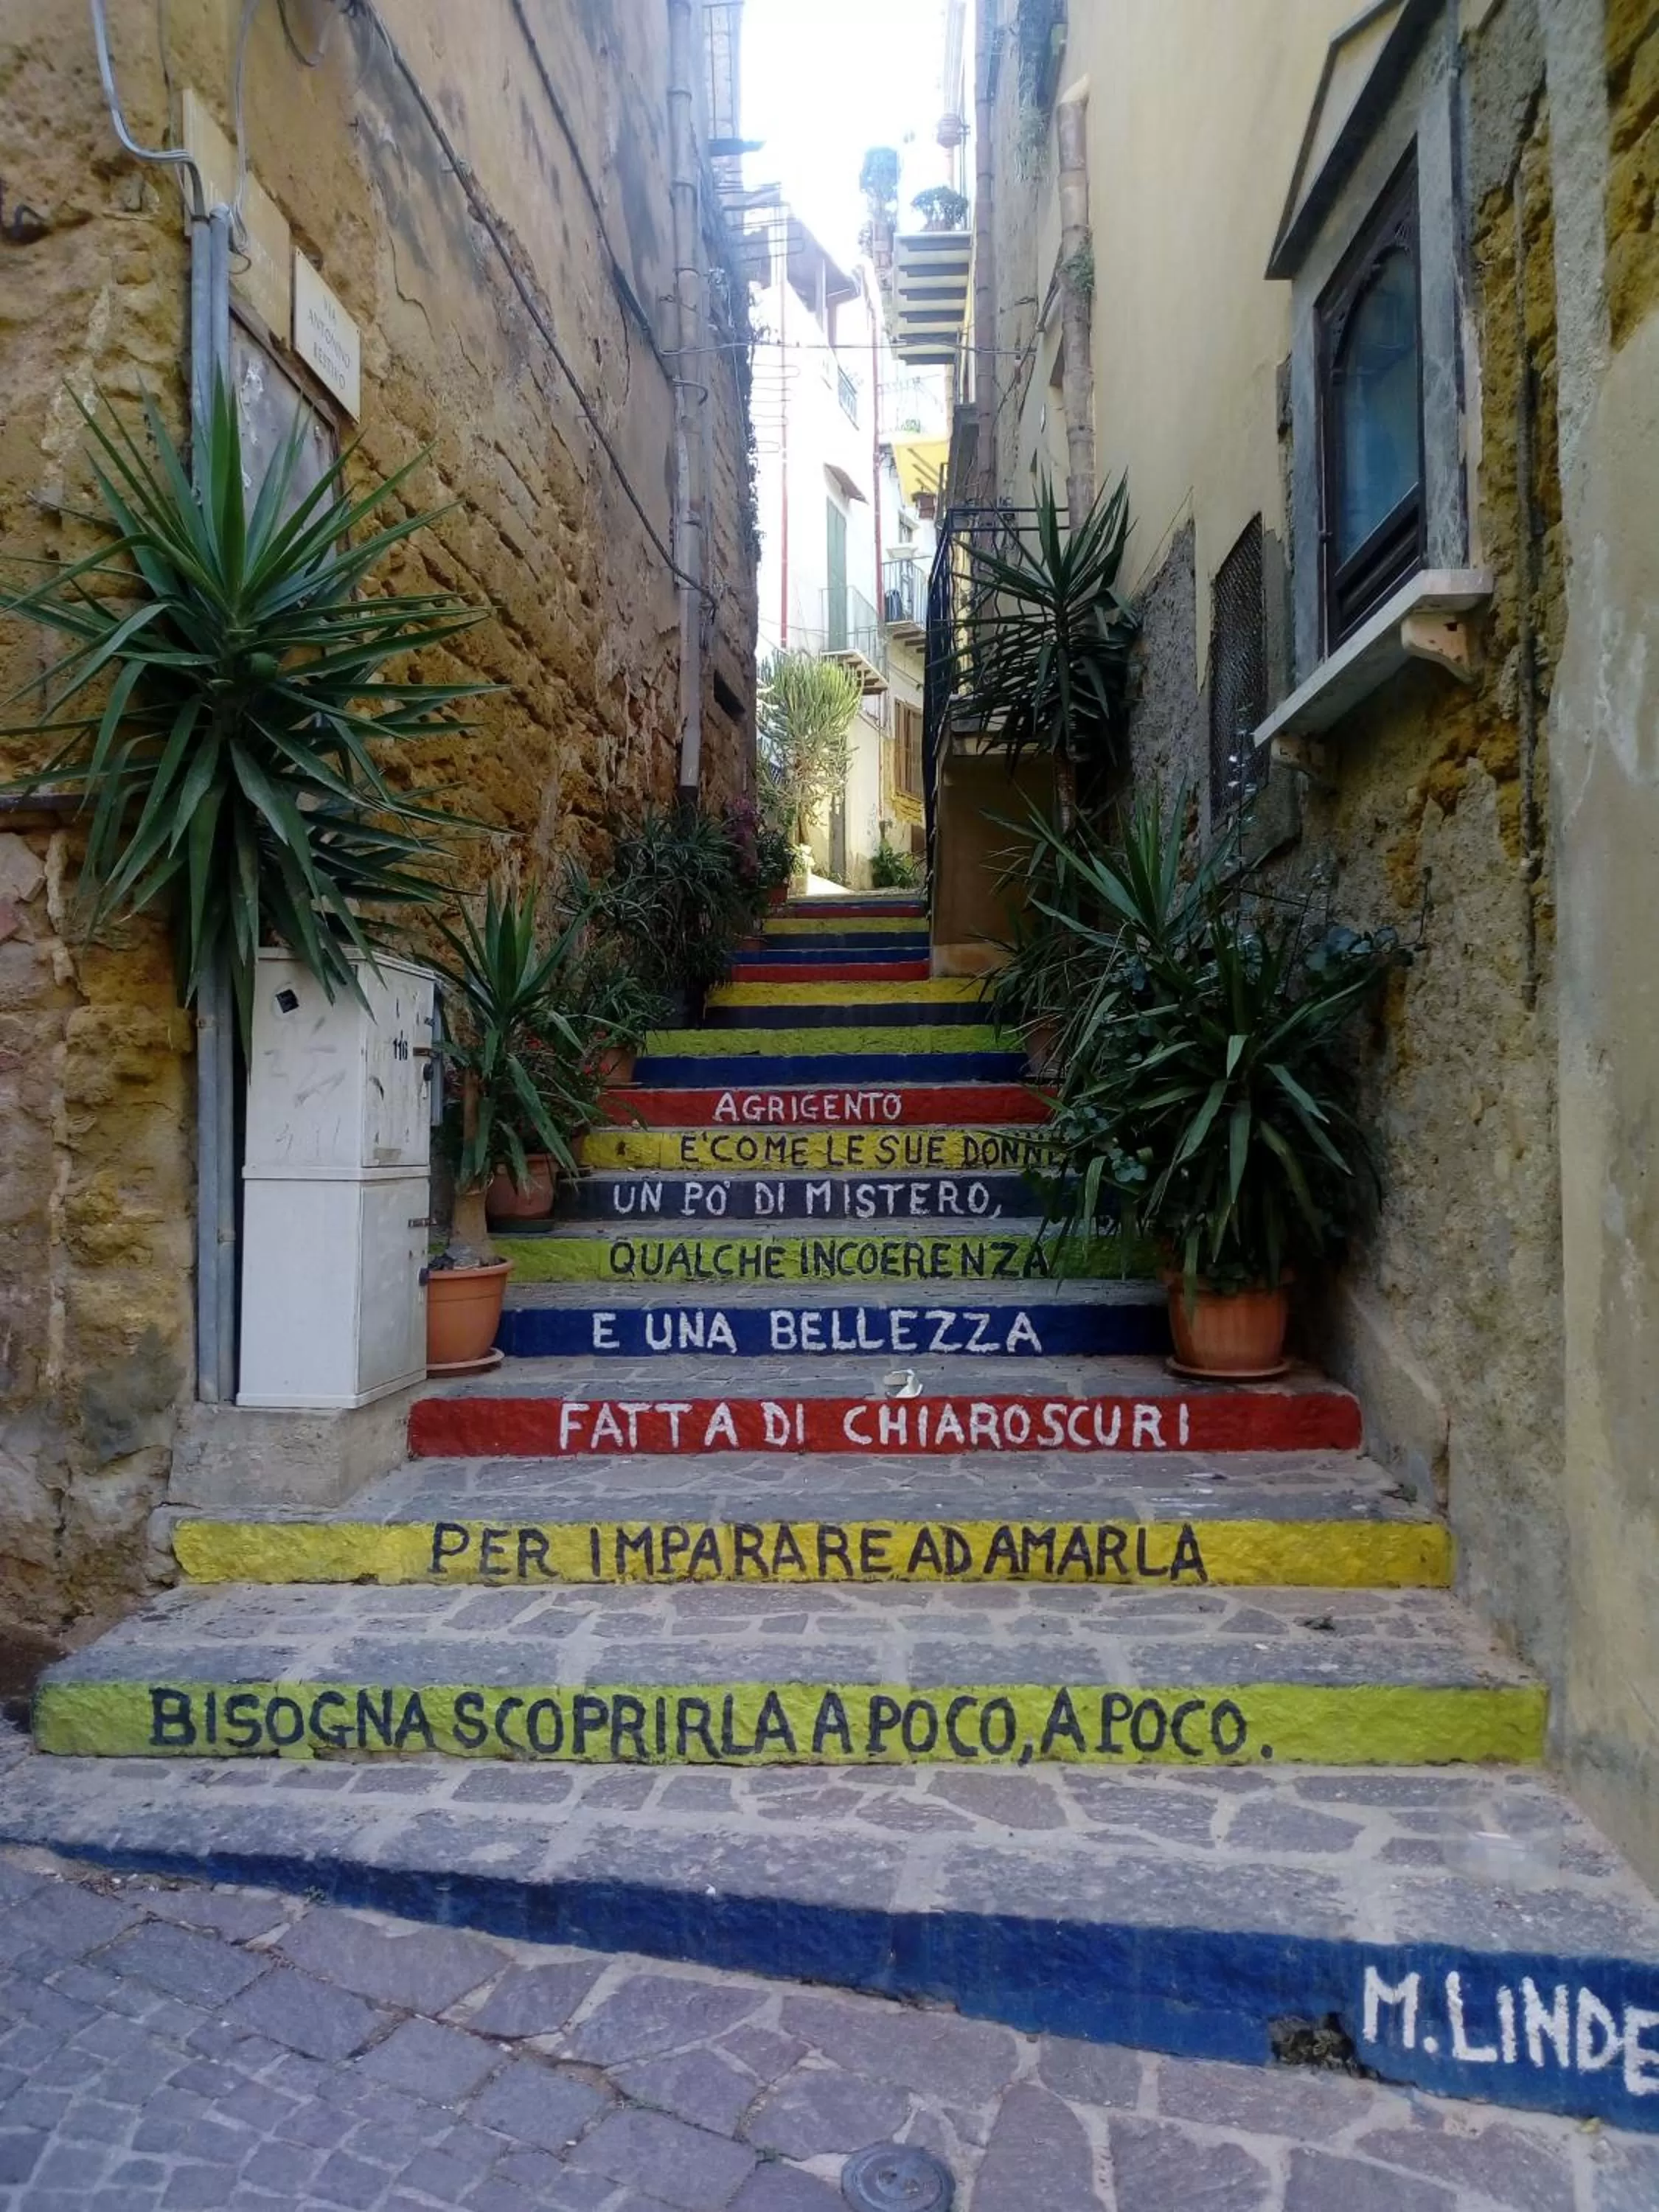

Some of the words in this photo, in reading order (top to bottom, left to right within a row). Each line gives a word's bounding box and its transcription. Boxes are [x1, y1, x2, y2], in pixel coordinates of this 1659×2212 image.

[323, 295, 336, 327] VIA
[712, 1091, 902, 1122] AGRIGENTO
[821, 1135, 866, 1166] LE
[874, 1134, 947, 1166] SUE
[612, 1180, 664, 1215] UN
[754, 1180, 786, 1215] DI
[609, 1239, 787, 1279] QUALCHE
[799, 1239, 1051, 1279] INCOERENZA
[592, 1311, 621, 1349] E
[644, 1310, 738, 1354] UNA
[768, 1307, 1043, 1354] BELLEZZA
[558, 1401, 738, 1450] FATTA
[760, 1400, 805, 1447] DI
[842, 1401, 1190, 1450] CHIAROSCURI
[427, 1521, 560, 1578] PER
[588, 1520, 893, 1579] IMPARARE
[906, 1524, 973, 1576] AD
[981, 1522, 1209, 1585] AMARLA
[147, 1686, 438, 1752] BISOGNA
[451, 1689, 799, 1759] SCOPRIRLA
[810, 1688, 855, 1754] A
[864, 1694, 1034, 1767] POCO,
[1040, 1686, 1088, 1756] A
[1094, 1691, 1273, 1760] POCO.
